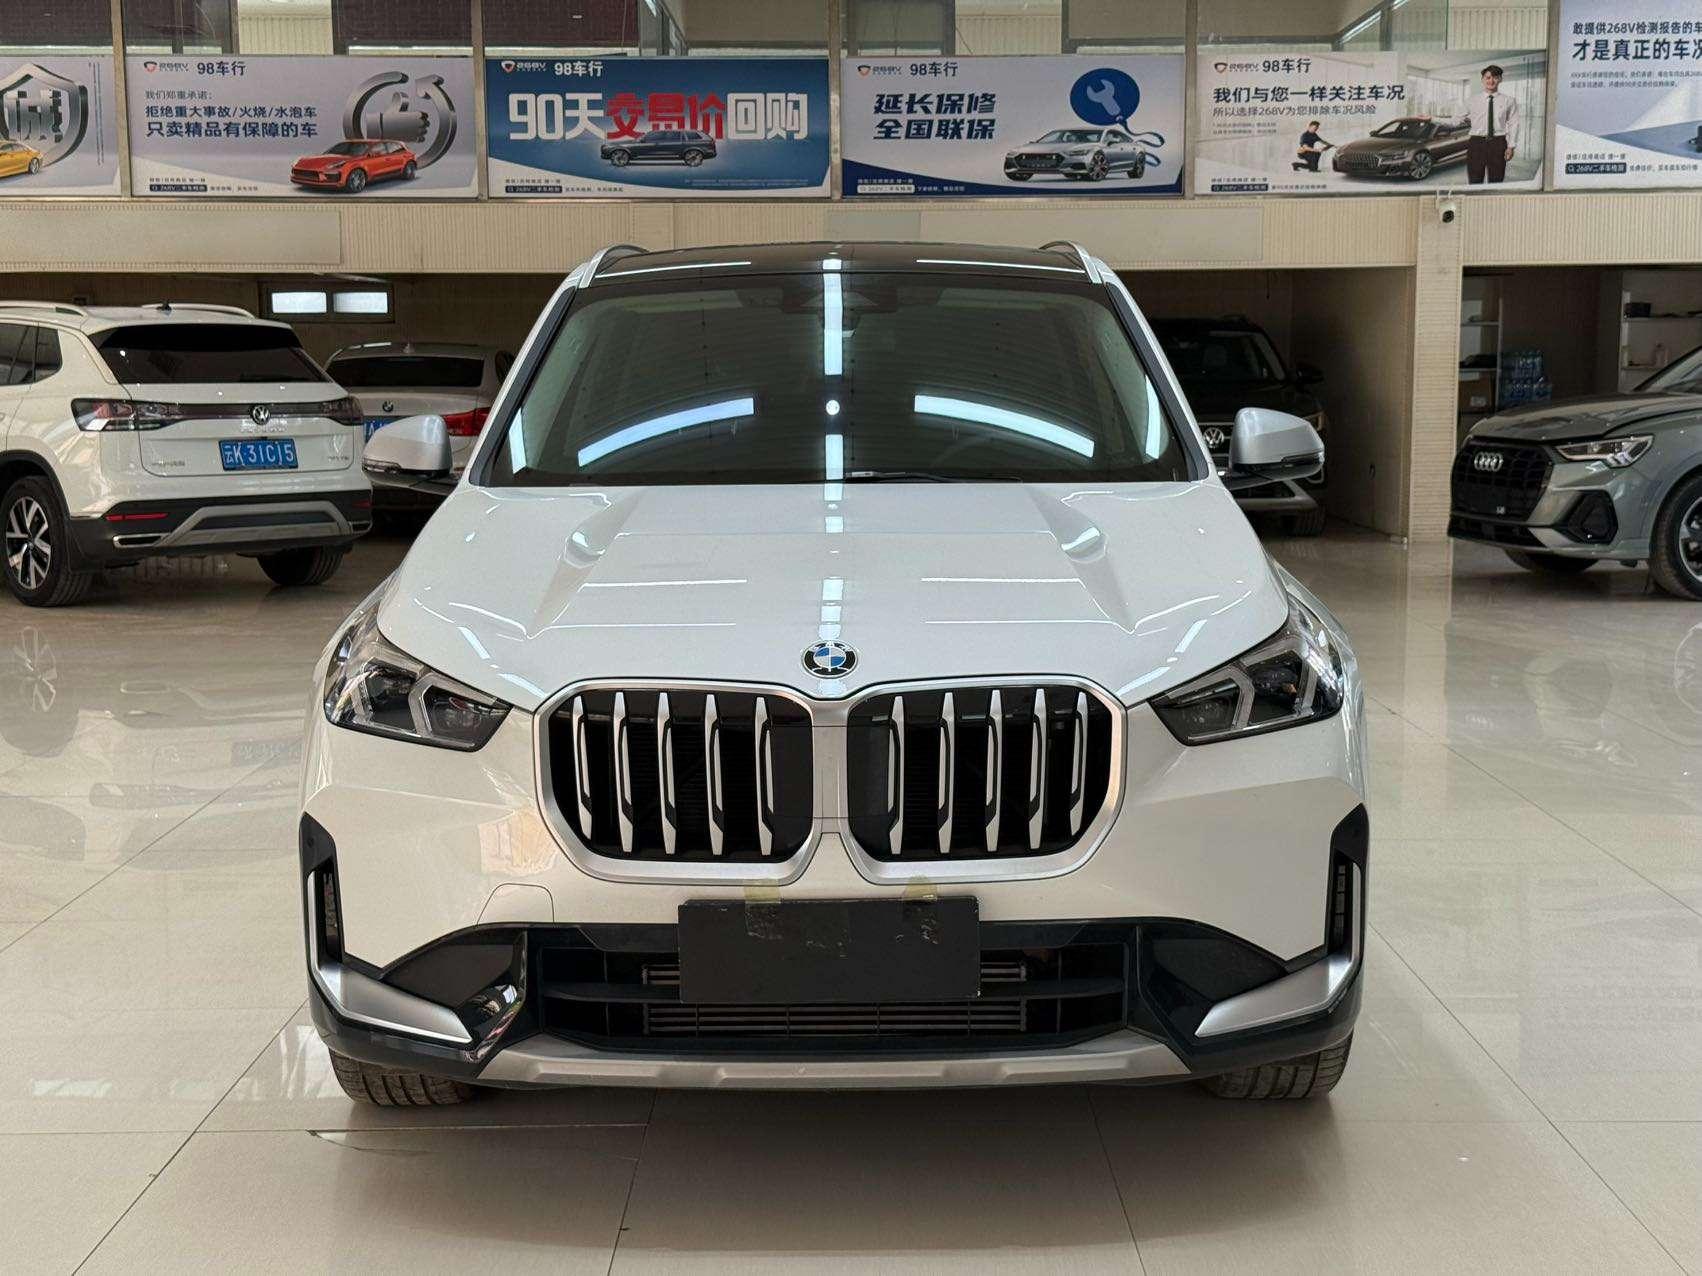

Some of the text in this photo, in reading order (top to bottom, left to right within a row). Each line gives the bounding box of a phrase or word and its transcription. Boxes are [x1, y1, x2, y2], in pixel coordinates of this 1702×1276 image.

[197, 61, 246, 76] 98车行
[554, 61, 603, 77] 98车行
[910, 62, 958, 77] 98车行
[1262, 58, 1312, 74] 98车行
[1213, 85, 1406, 103] 我们与您一样关注车况
[145, 105, 318, 118] 拒绝重大事故/火烧/水泡车
[873, 93, 996, 115] 延长保修
[508, 92, 808, 140] 90天交易价回购
[146, 121, 318, 138] 只卖精品有保障的车
[873, 118, 996, 140] 全国联保
